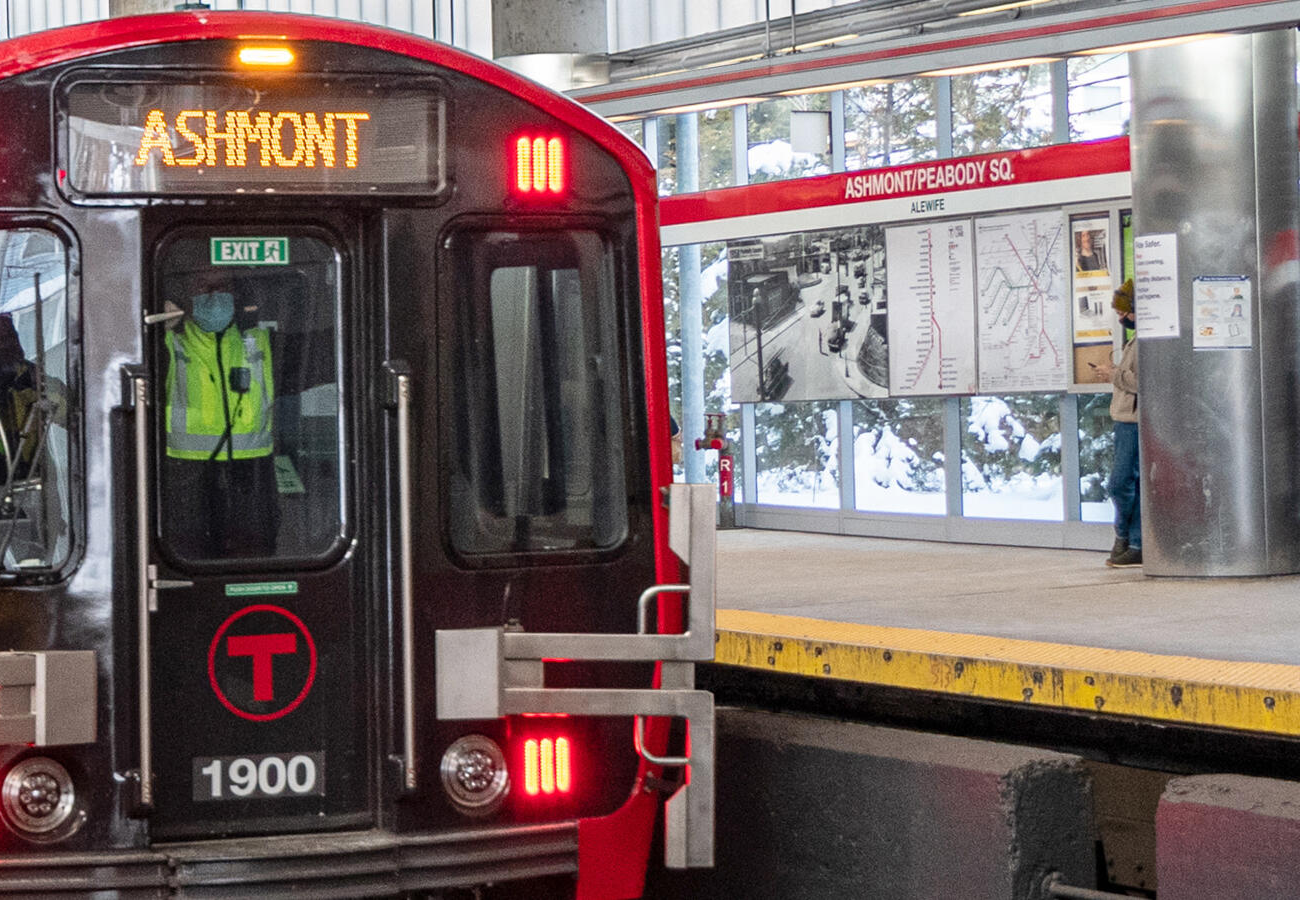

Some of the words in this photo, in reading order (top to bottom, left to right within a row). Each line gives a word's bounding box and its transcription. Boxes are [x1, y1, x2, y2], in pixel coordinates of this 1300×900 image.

[134, 109, 371, 167] ASHMONT
[844, 160, 988, 199] ASHMONT/PEABODY
[989, 157, 1015, 182] SQ.
[910, 198, 945, 214] ALEWIFE
[221, 241, 260, 261] EXIT
[720, 459, 731, 472] R
[722, 480, 728, 494] 1
[227, 633, 297, 701] T
[202, 755, 316, 797] 1900
